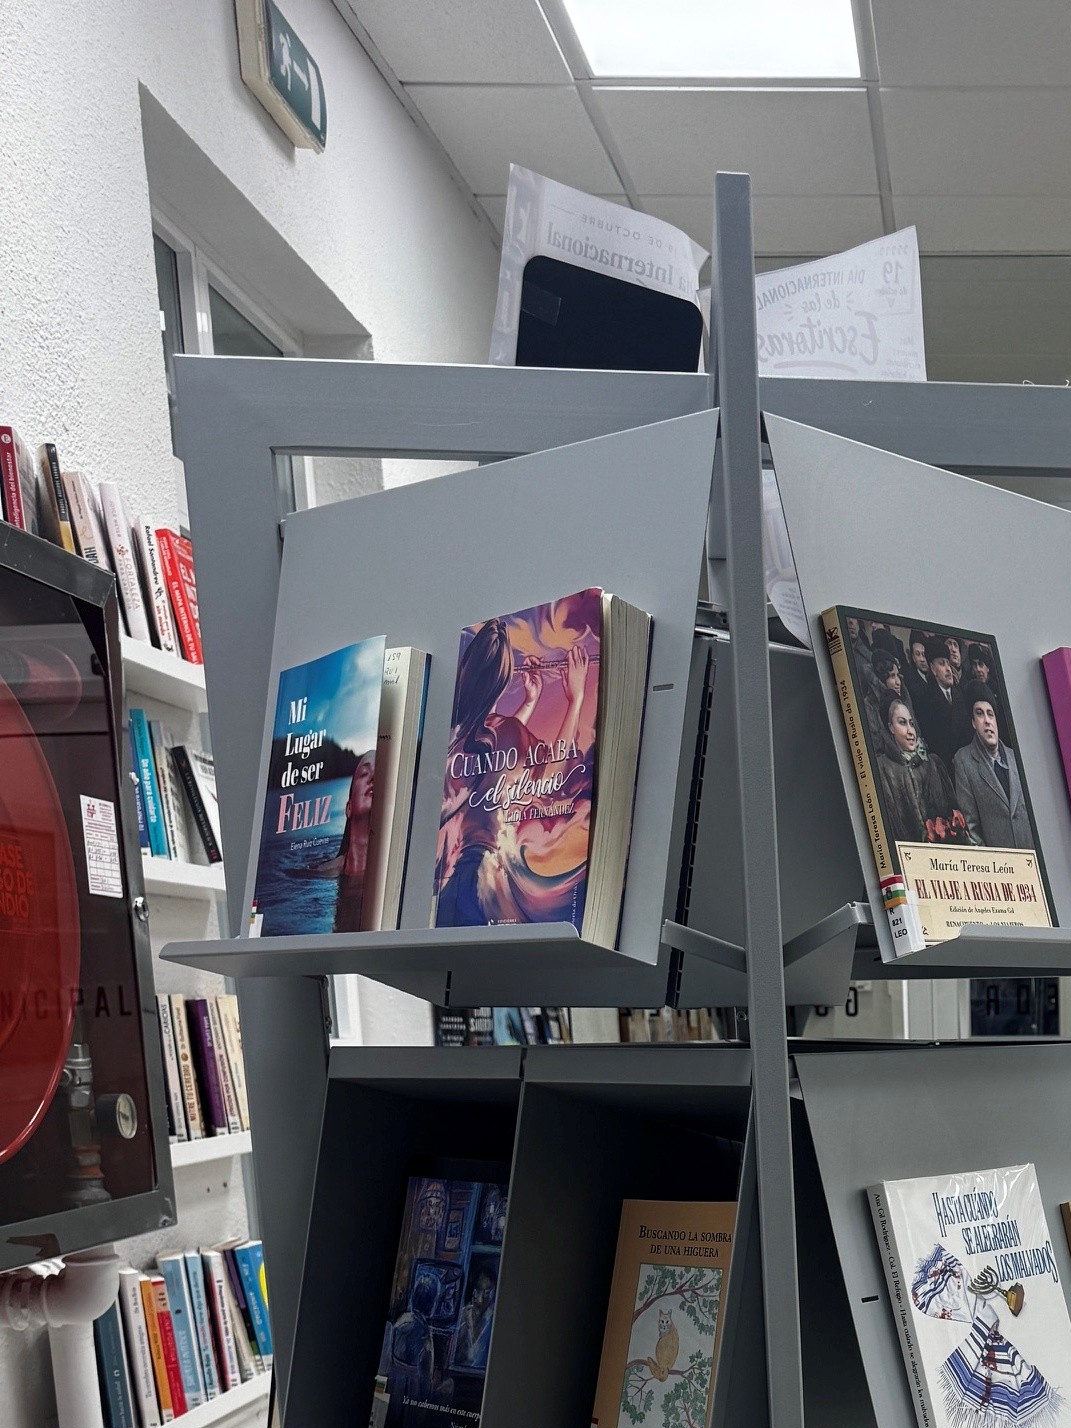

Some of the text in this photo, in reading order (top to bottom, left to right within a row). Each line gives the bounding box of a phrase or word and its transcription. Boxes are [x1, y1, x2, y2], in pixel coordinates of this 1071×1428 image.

[6, 452, 14, 480] bienestar
[144, 525, 160, 586] Rafael Santandreu
[125, 553, 142, 611] FORTALEZA
[288, 697, 307, 725] Mi
[845, 703, 853, 714] de
[848, 716, 858, 739] Rusia
[285, 729, 327, 760] Lugar
[451, 738, 579, 779] CUANDO ACABA
[856, 748, 866, 770] viaje
[281, 761, 324, 788] de ser
[500, 764, 586, 812] silencio
[859, 770, 867, 779] El
[276, 793, 333, 834] FELIZ
[866, 793, 887, 869] María Teresa León
[290, 841, 303, 851] Elena
[930, 858, 1015, 874] María Teresa León
[914, 879, 1038, 903] EL VIAJE A RUSIA DE 1934
[892, 918, 903, 927] 821
[949, 905, 967, 914] Edición
[894, 928, 908, 939] LEO
[932, 1186, 999, 1238] HASTA CUÁNDO
[639, 1224, 732, 1244] BUSCANDO LA SOMBRA
[880, 1217, 891, 1251] Rodríguez
[962, 1214, 1022, 1256] SE ALEGRARÁN
[650, 1243, 719, 1258] DE UNA HIGUERA
[995, 1240, 1059, 1284] LOS MALVADOS
